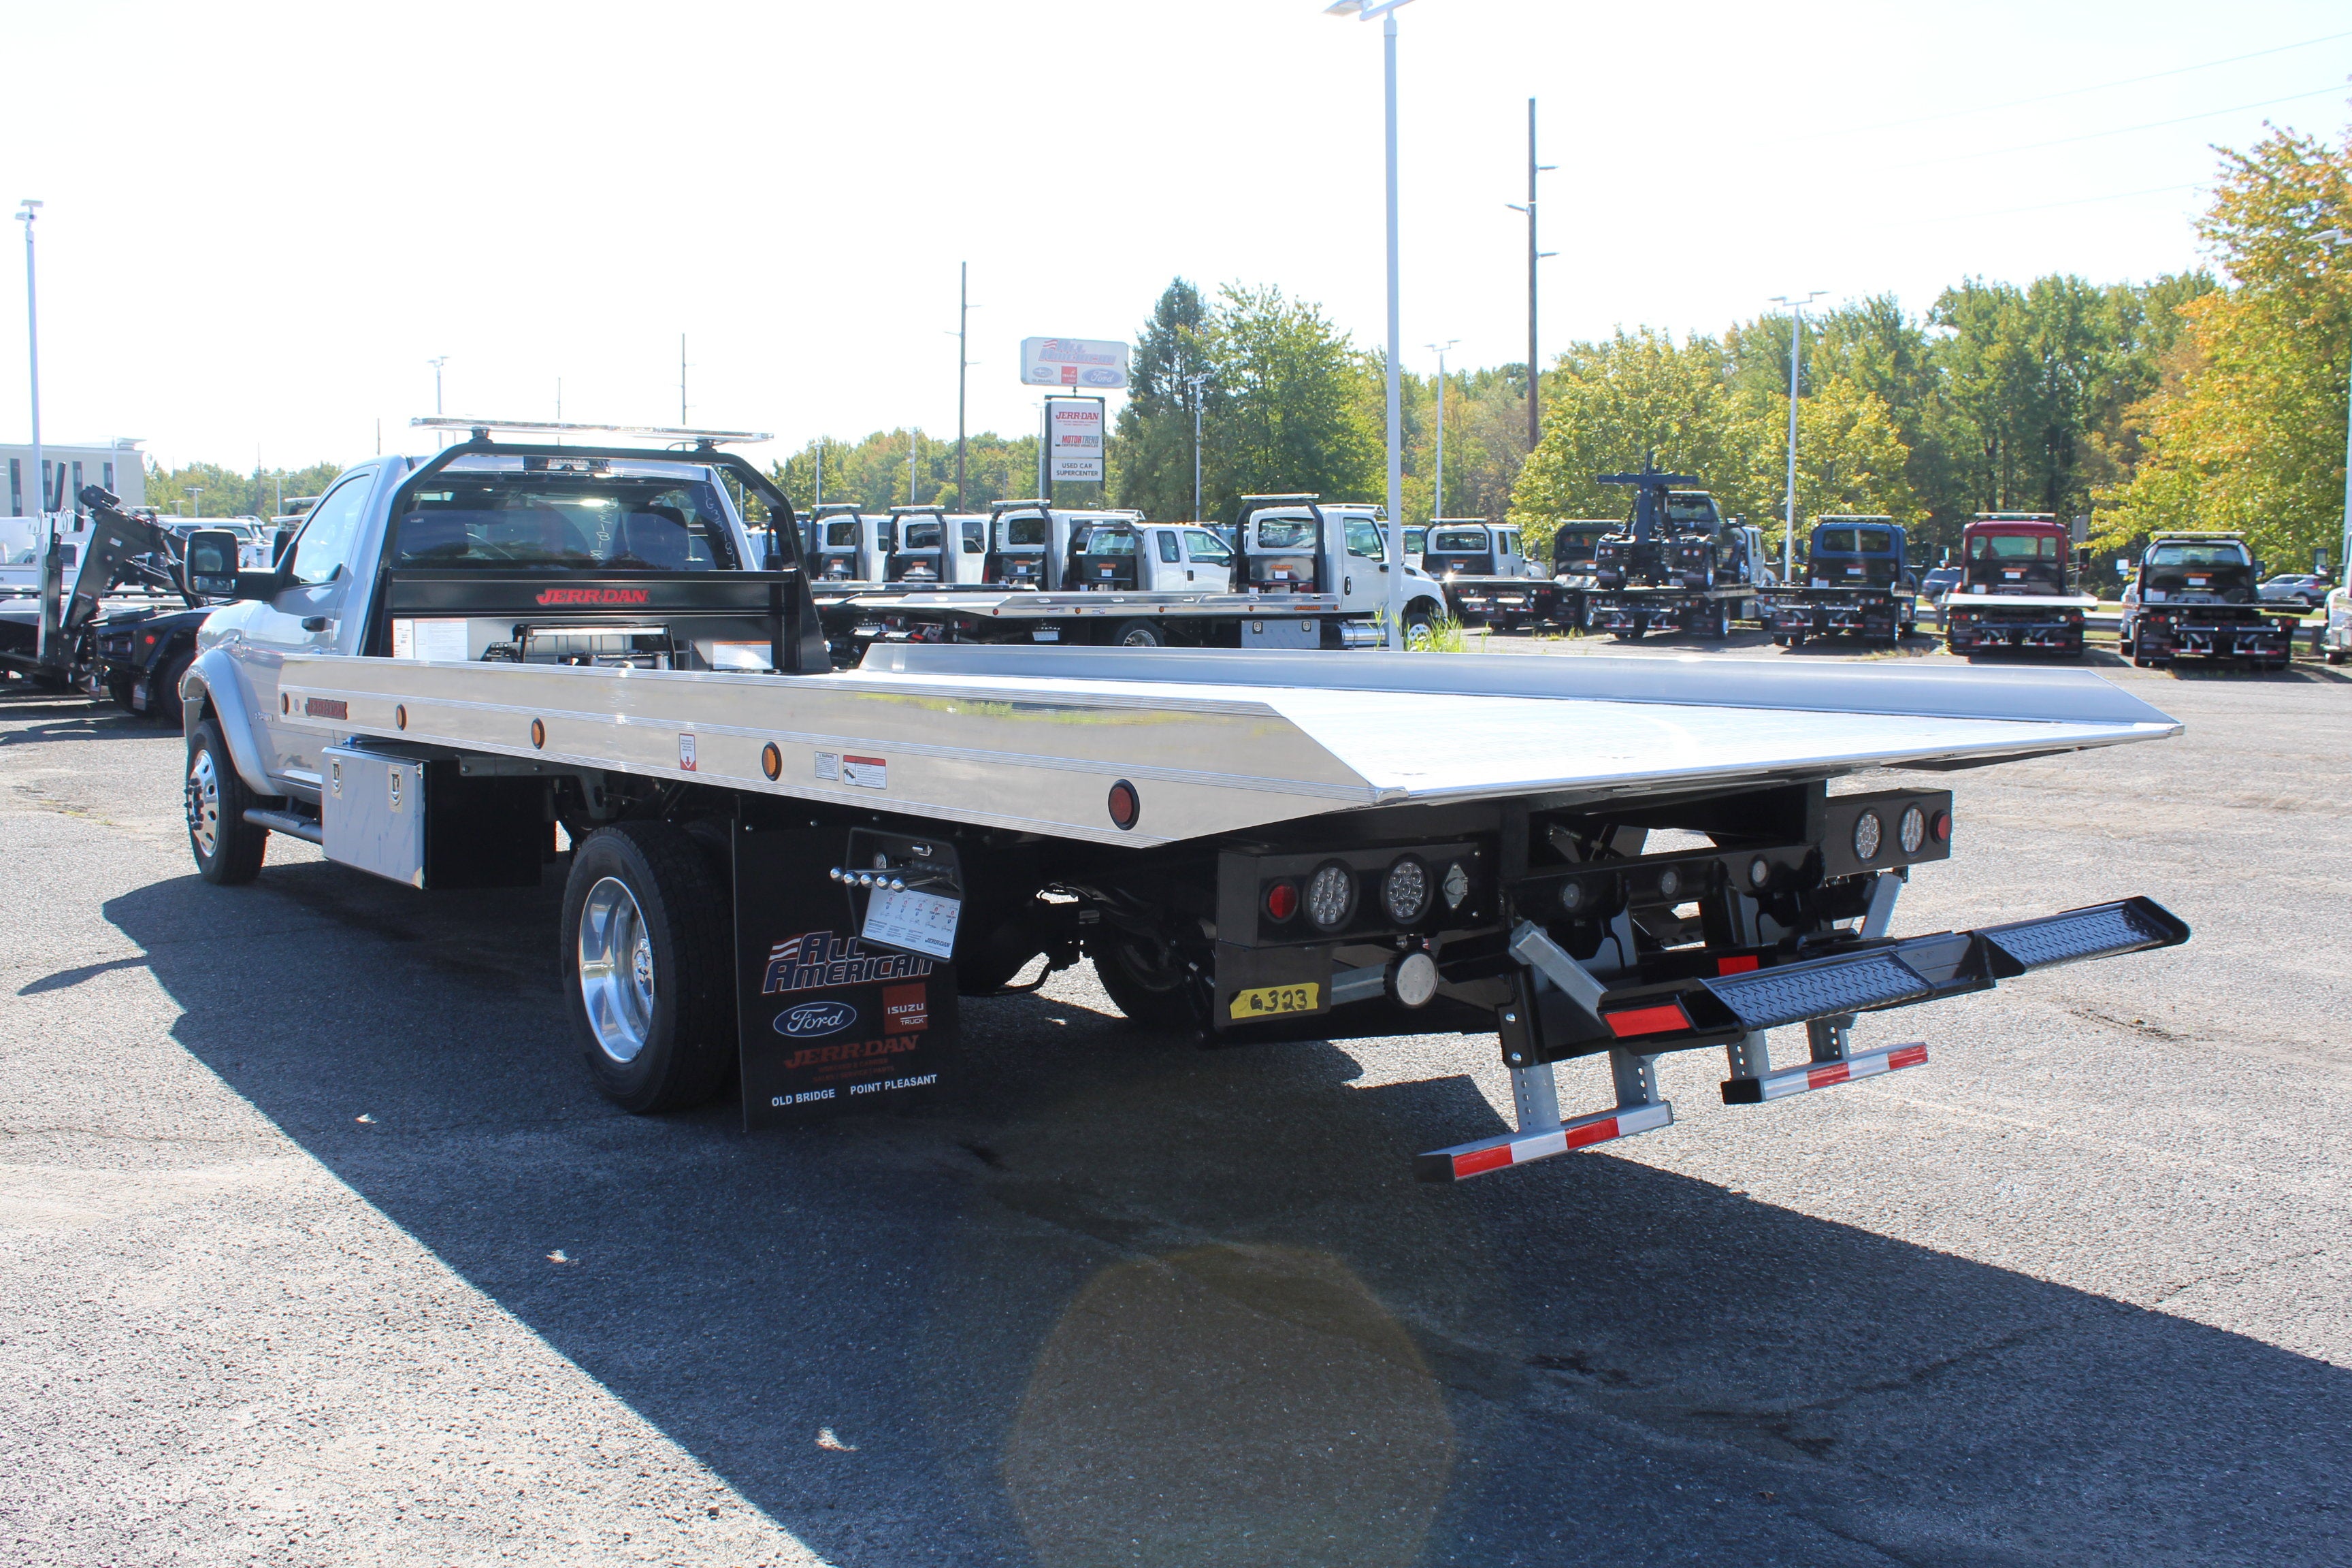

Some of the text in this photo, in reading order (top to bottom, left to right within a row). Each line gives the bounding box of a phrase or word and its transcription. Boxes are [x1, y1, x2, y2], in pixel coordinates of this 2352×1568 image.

[1091, 370, 1115, 382] Ford
[887, 1002, 925, 1015] ISUZU
[787, 1007, 844, 1032] Ford
[900, 1017, 924, 1026] TRUCK
[850, 1074, 937, 1095] POINT PLEASANT
[771, 1089, 836, 1107] OLD BRIDGE
